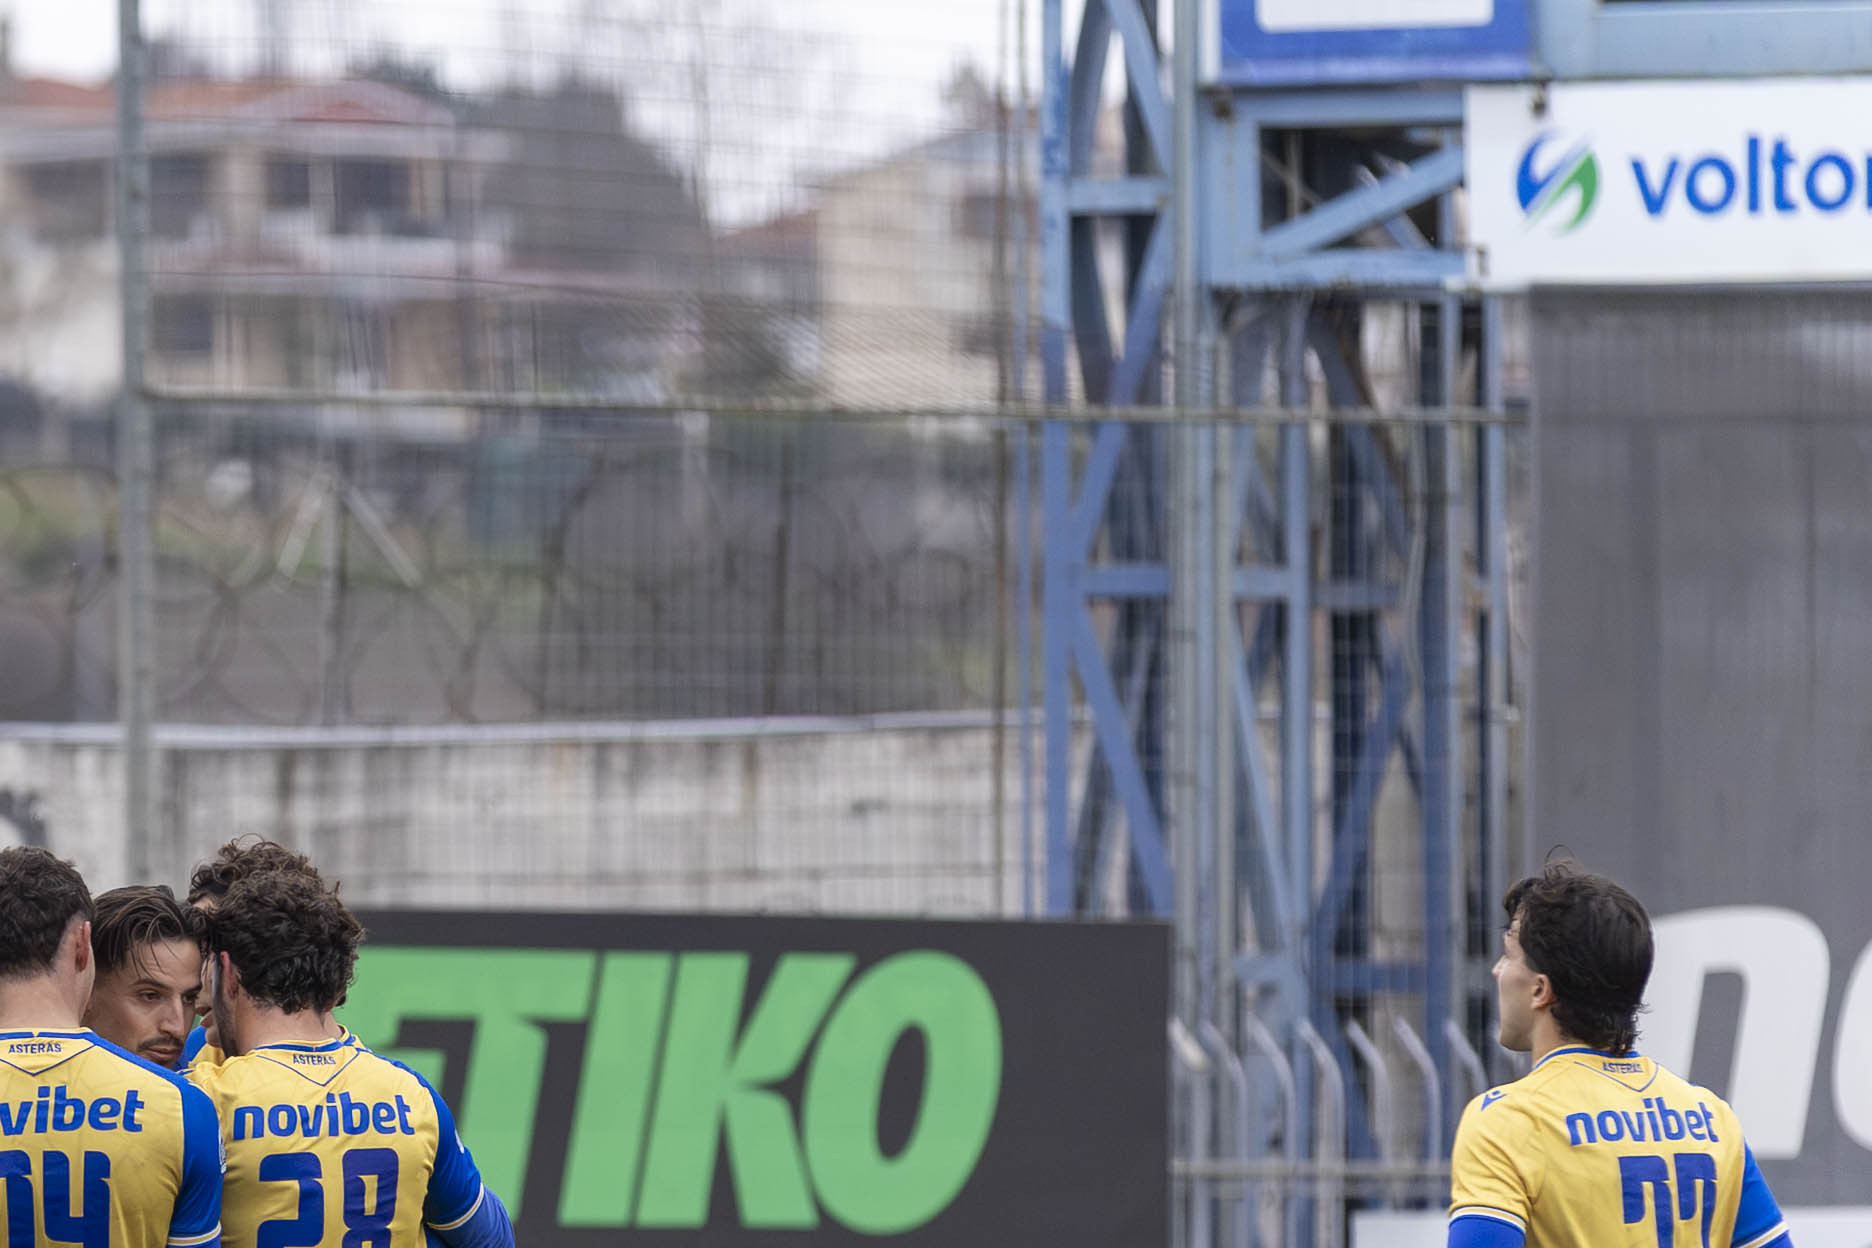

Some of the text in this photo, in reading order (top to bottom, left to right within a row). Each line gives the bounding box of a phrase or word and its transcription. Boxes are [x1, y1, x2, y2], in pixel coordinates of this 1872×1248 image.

[1630, 135, 1872, 215] volto
[8, 1042, 62, 1054] ASTERAS
[292, 1053, 337, 1065] ASTERAS
[232, 1092, 415, 1139] novibet
[1565, 1097, 1720, 1146] novibet
